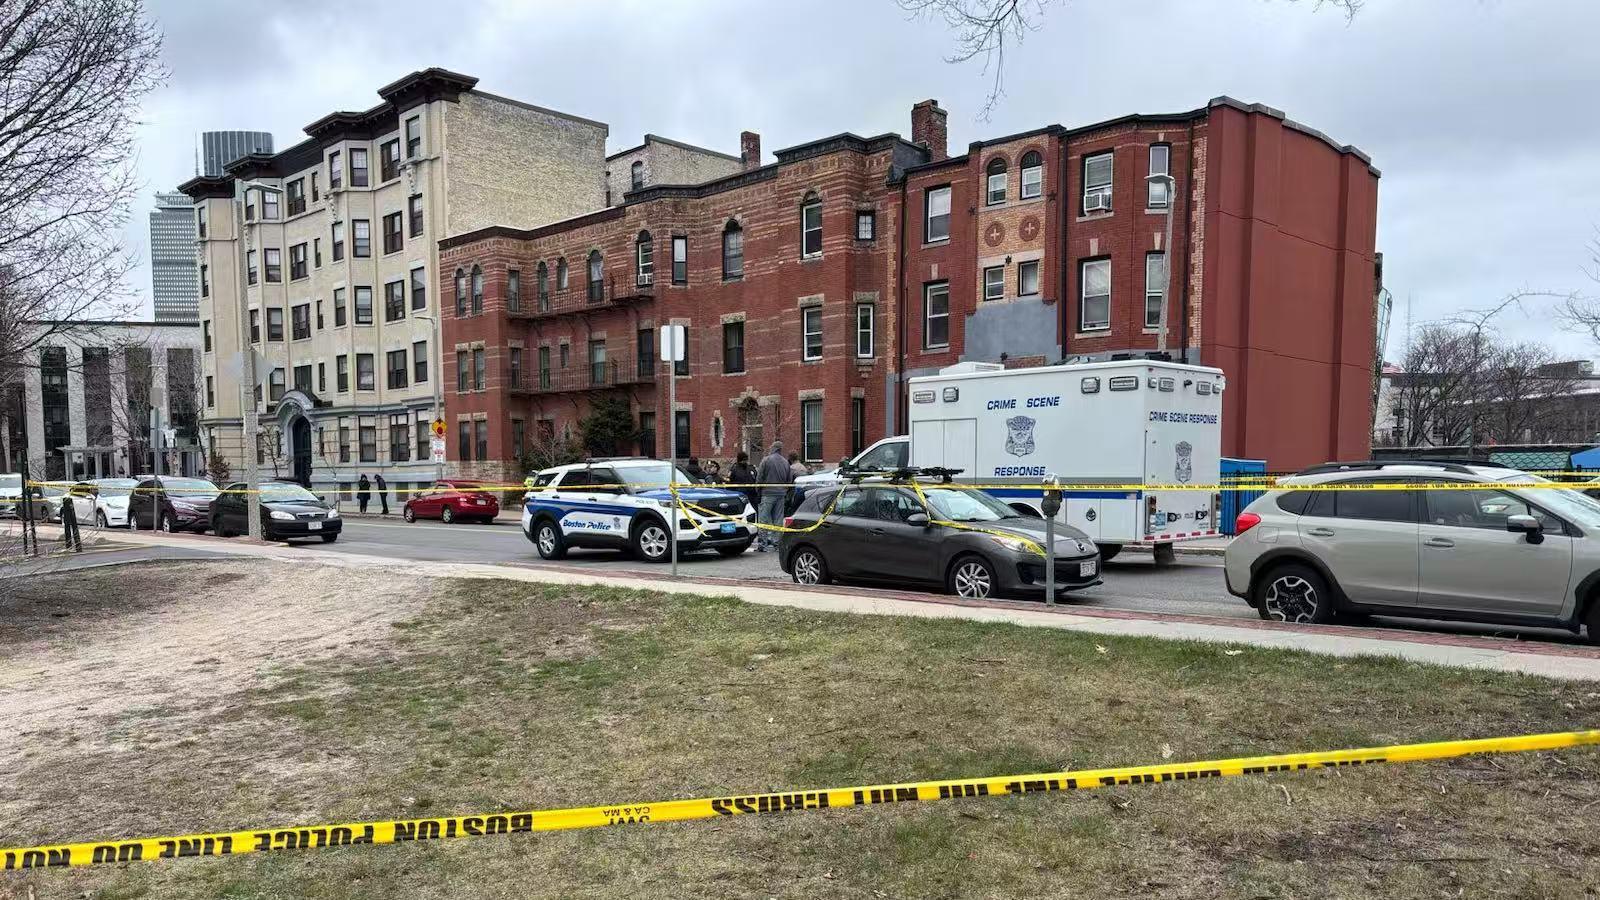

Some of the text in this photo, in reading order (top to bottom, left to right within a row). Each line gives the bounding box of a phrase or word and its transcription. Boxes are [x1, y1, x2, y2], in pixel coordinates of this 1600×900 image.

[987, 396, 1060, 410] CRIME SCENE
[1149, 411, 1218, 424] CRIME SCENE RESPONSE
[994, 466, 1046, 476] RESPONSE
[562, 519, 611, 530] Boston Police
[603, 806, 650, 817] CA & MA
